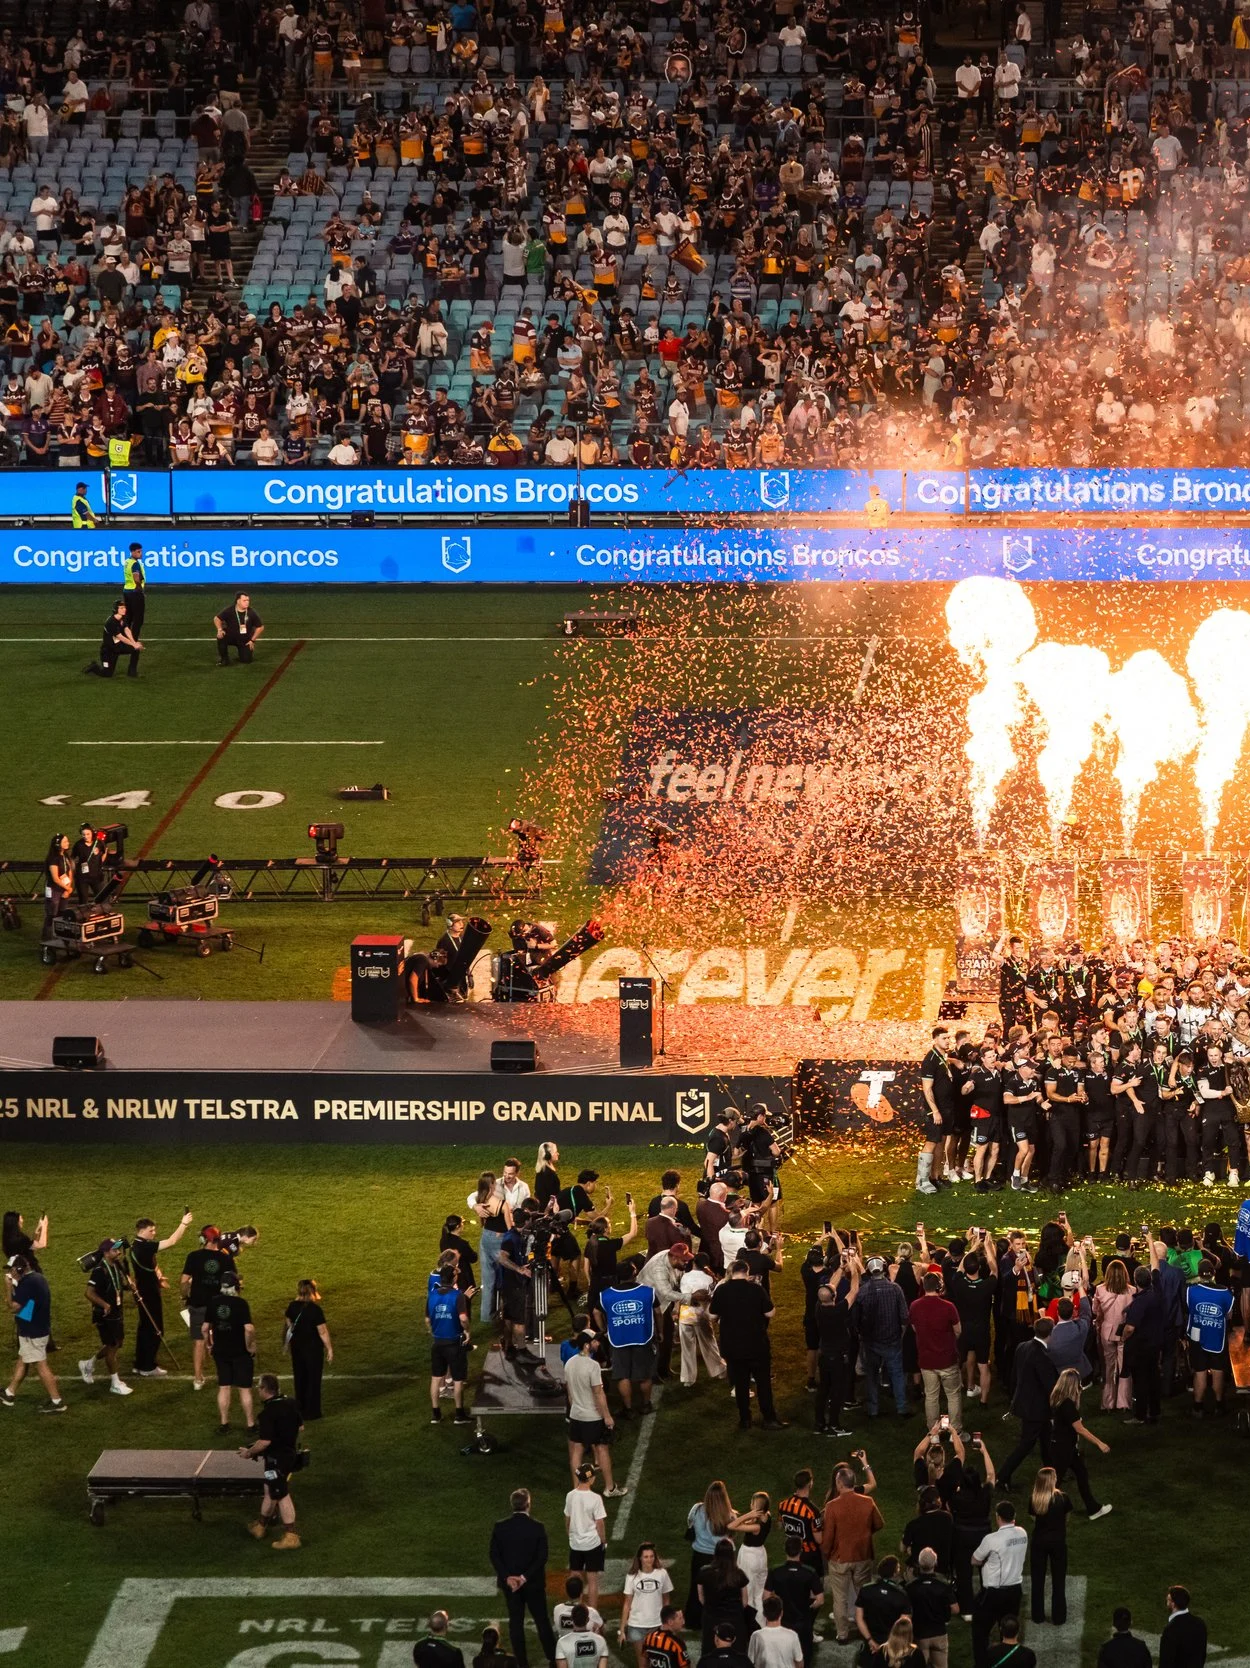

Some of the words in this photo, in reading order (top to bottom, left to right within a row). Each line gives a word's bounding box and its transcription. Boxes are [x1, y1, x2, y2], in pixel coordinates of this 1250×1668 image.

[263, 477, 508, 510] Congratulations
[515, 478, 639, 504] Broncos
[917, 474, 1166, 510] Congratulations
[13, 545, 225, 572] Congratuations
[231, 546, 339, 568] Broncos
[575, 543, 788, 571] Congratulations
[793, 544, 901, 568] Broncos
[27, 1098, 76, 1119] NRL
[82, 1098, 99, 1119] &
[107, 1098, 178, 1119] NRLW
[184, 1099, 299, 1120] TELSTRA
[314, 1100, 486, 1121] PREMIERSHIP
[493, 1101, 581, 1122] GRAND
[588, 1101, 662, 1122] FINAL
[612, 1317, 645, 1327] SPORTS
[239, 1619, 340, 1633] NRL
